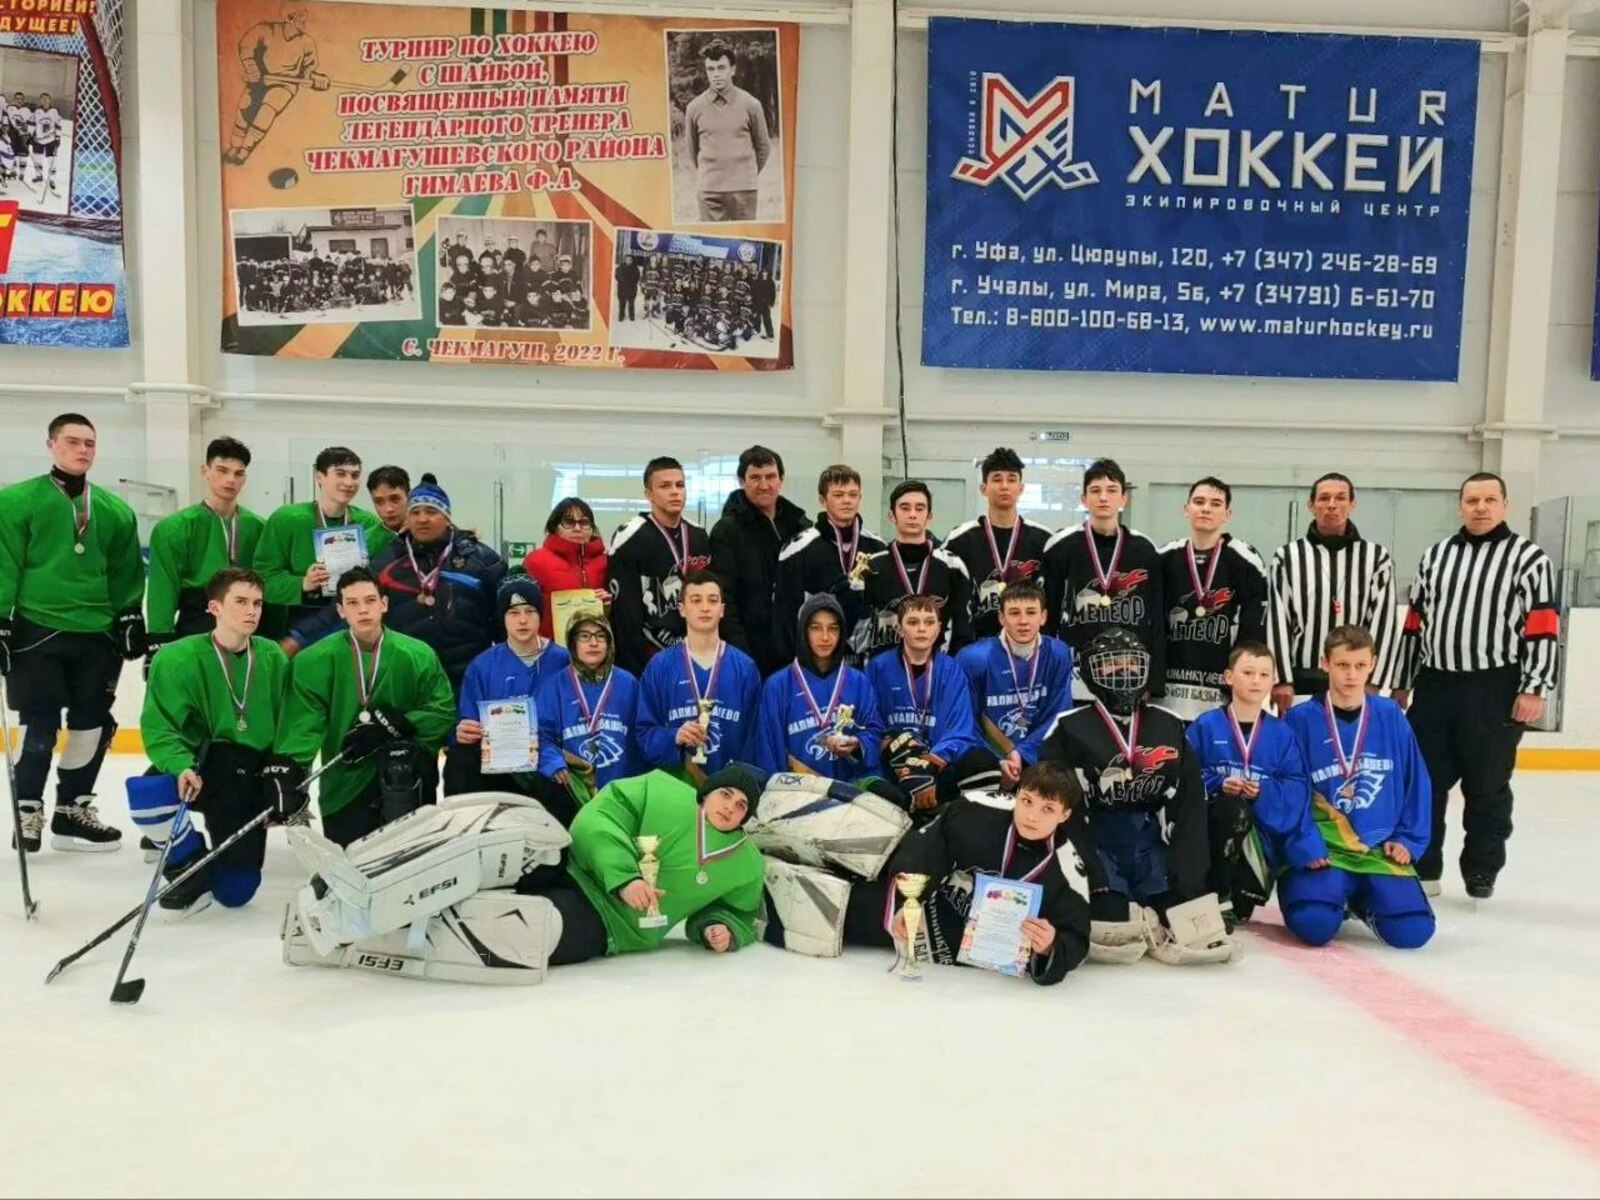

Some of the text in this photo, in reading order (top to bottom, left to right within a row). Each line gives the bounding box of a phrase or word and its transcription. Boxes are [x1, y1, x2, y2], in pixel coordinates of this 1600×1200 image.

[362, 32, 597, 60] ТУРНИР ПО ХОККЕЮ
[419, 58, 549, 85] С ШАЙБОЙ,
[339, 83, 629, 115] ПОСВЯЩЕННЫЙ ПАМЯТИ
[1129, 78, 1446, 126] MATUR
[344, 111, 631, 142] ЛЕГЕНДАРНОГО ТРЕНЕРА
[306, 134, 667, 171] ЧЕКМАГУШЕВСКОГО РАЙОНА
[1126, 125, 1444, 194] ХОККЕЙ
[403, 168, 580, 196] ГИМАЕВА Ф.А.
[1125, 195, 1441, 217] ЭКИПИРОВОЧНЫЙ ЦЕНТР
[952, 241, 1438, 275] г. Уфа, ул. Цюрупы, 120, +7 (347) 246-28-69
[951, 279, 967, 294] г.
[977, 275, 1054, 299] Учалы,
[1064, 281, 1095, 300] ул.
[1105, 279, 1168, 304] Мира,
[1219, 284, 1245, 303] +7
[1255, 282, 1341, 309] (34791)
[1350, 287, 1435, 309] 6-61-70
[951, 306, 1433, 340] Тел.: 8-800-100-68-13, www.maturhockey.ru
[427, 339, 549, 361] ЧЕКМАГУШ,
[555, 344, 603, 361] 2022
[419, 876, 458, 900] EFSI
[359, 954, 404, 971] EFSI
